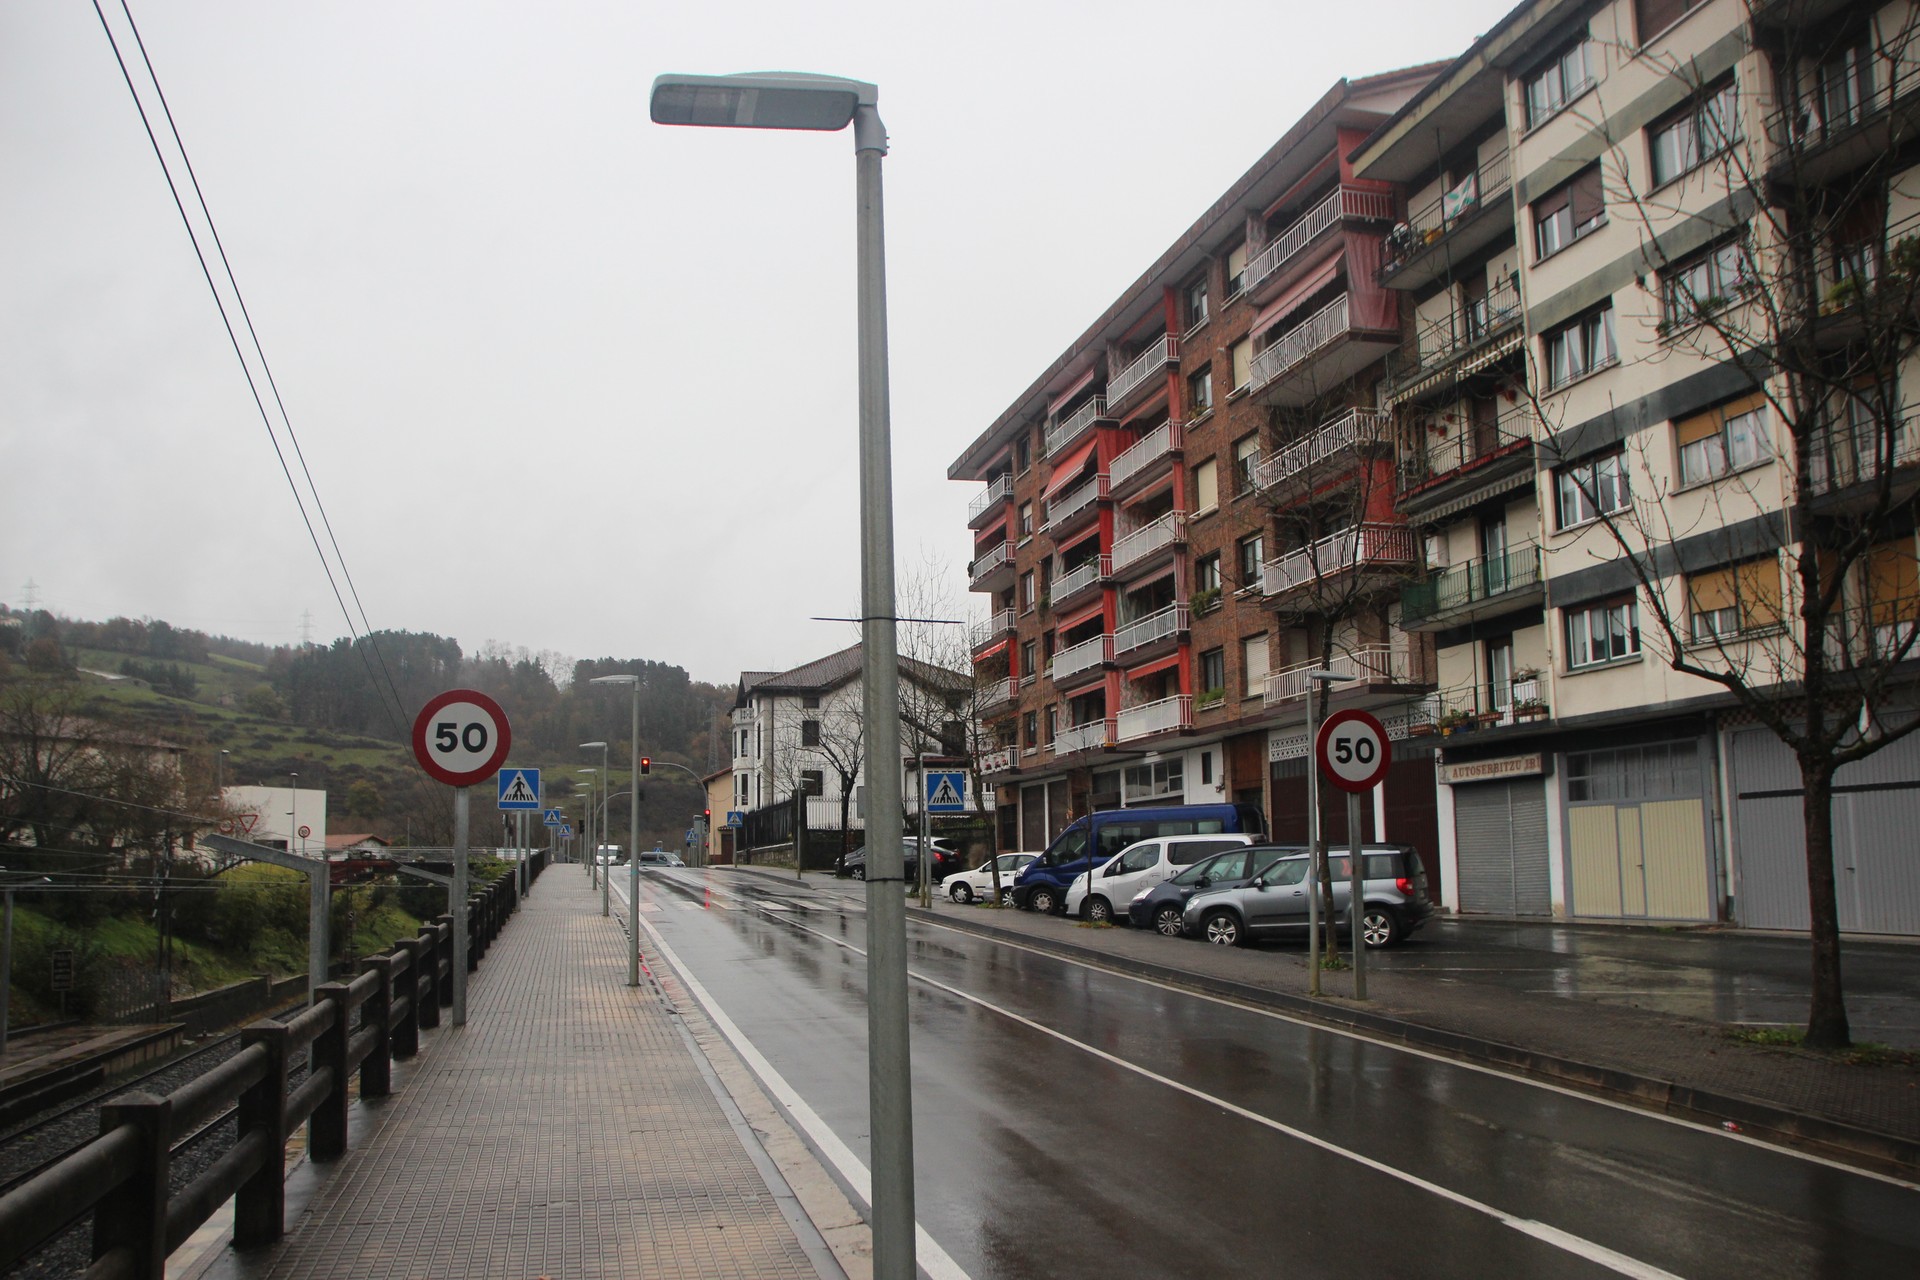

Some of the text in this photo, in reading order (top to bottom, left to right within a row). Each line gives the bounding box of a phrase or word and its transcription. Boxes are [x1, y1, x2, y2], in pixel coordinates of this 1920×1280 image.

[436, 722, 488, 753] 50
[1335, 737, 1375, 764] 50
[1452, 759, 1522, 778] AUTOSERBITZU
